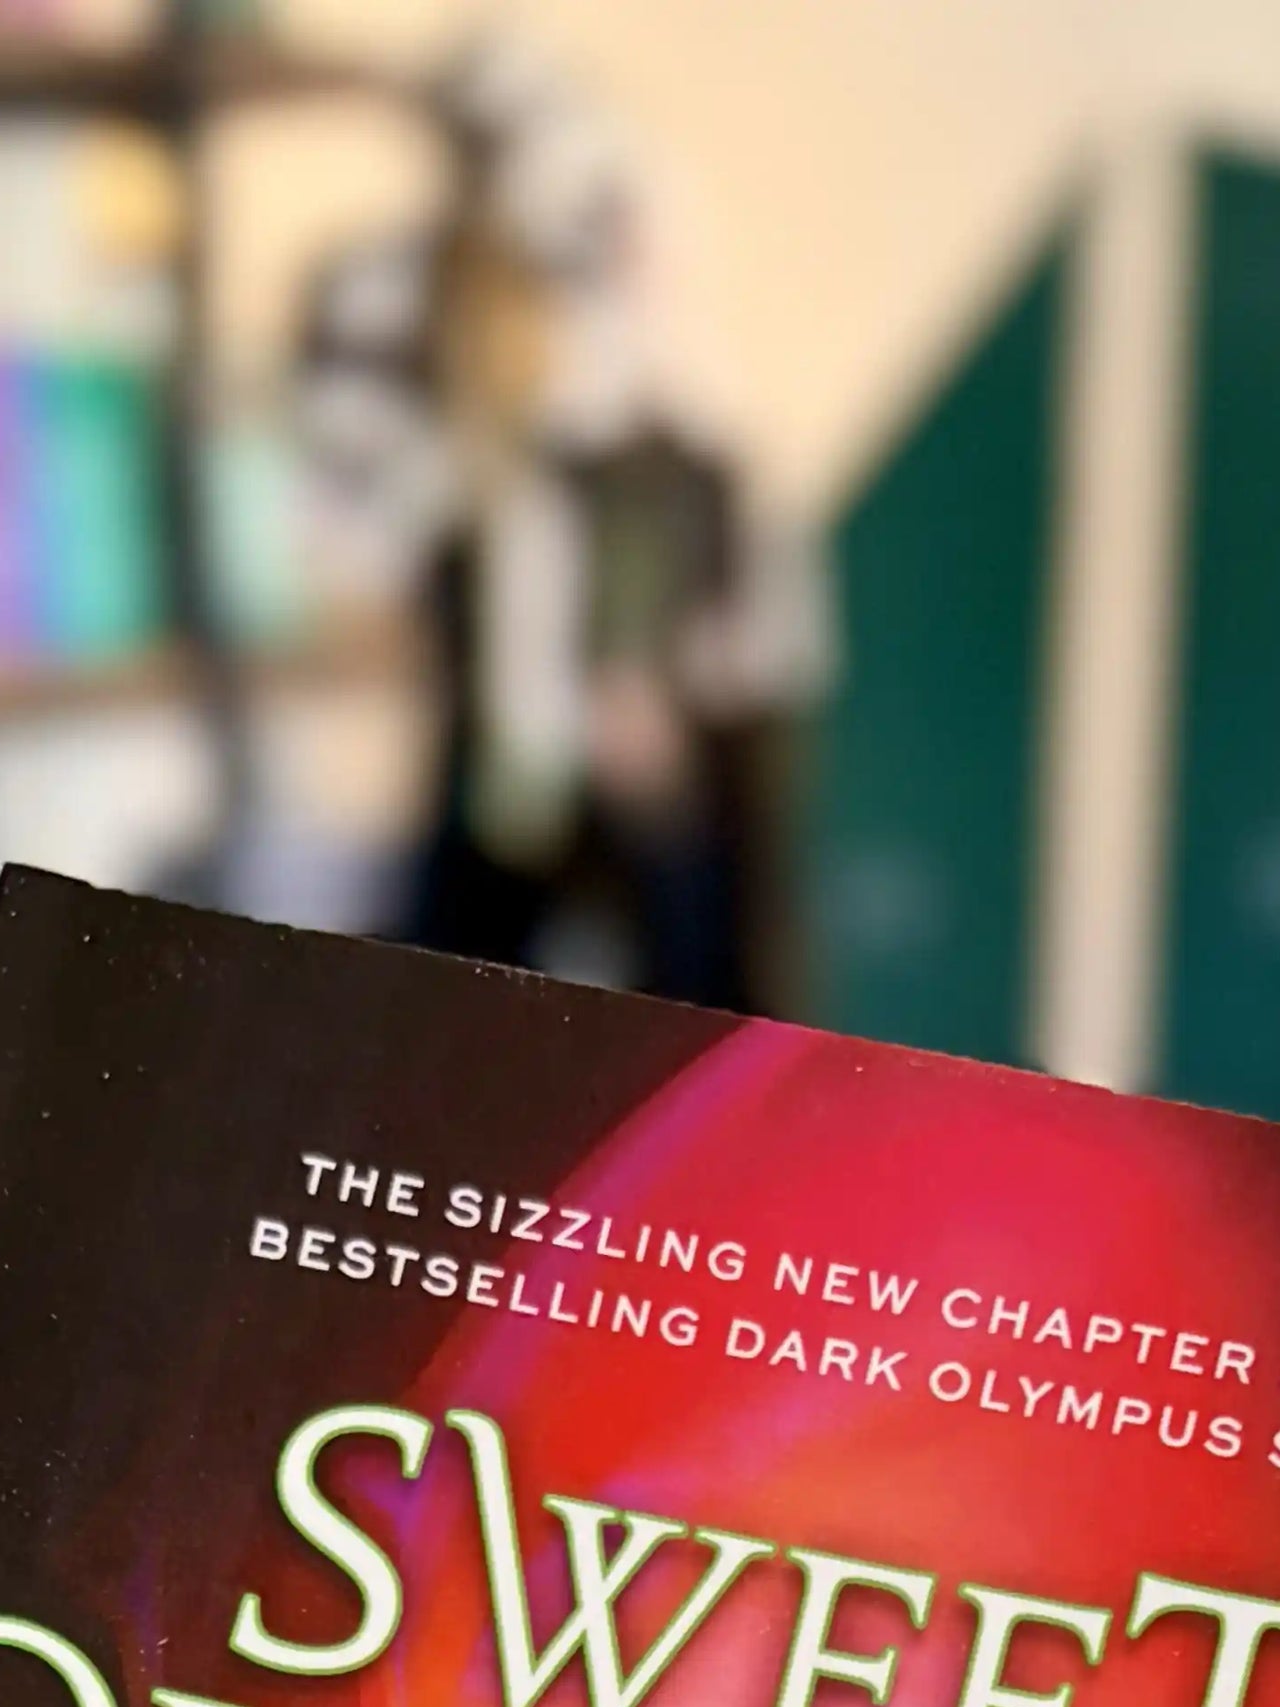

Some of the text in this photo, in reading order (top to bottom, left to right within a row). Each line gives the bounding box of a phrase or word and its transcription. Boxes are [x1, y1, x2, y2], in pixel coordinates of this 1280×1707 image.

[248, 1216, 700, 1347] BESTSELLING
[724, 1318, 909, 1391] DARK
[927, 1360, 1245, 1459] OLYMPUS
[301, 1153, 425, 1218] THE
[444, 1186, 748, 1282] SIZZLING
[772, 1251, 919, 1316] NEW
[940, 1287, 1256, 1385] CHAPTER
